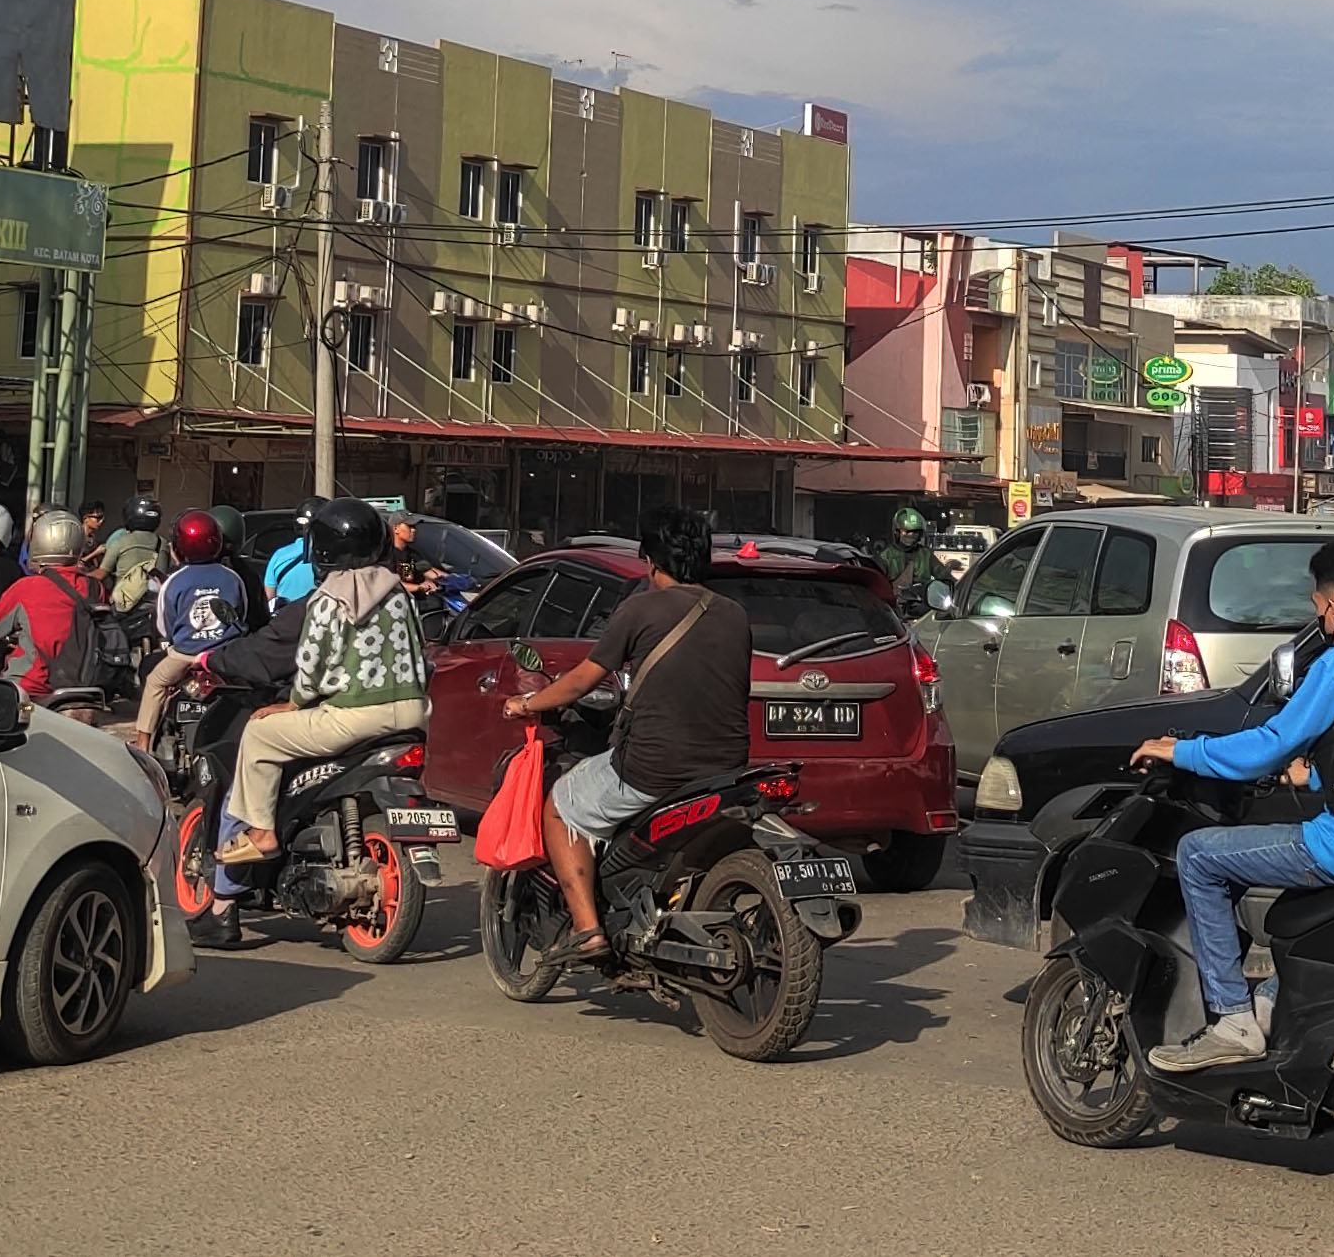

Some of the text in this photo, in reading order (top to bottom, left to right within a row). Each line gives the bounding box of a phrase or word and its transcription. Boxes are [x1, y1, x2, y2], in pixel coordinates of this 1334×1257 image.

[53, 248, 79, 264] BATAM
[80, 252, 100, 266] KOTA
[1151, 365, 1183, 376] prima
[768, 705, 787, 722] BP
[290, 762, 336, 790] STREET
[390, 812, 403, 825] BP
[649, 794, 722, 843] 150
[777, 864, 793, 881] BP
